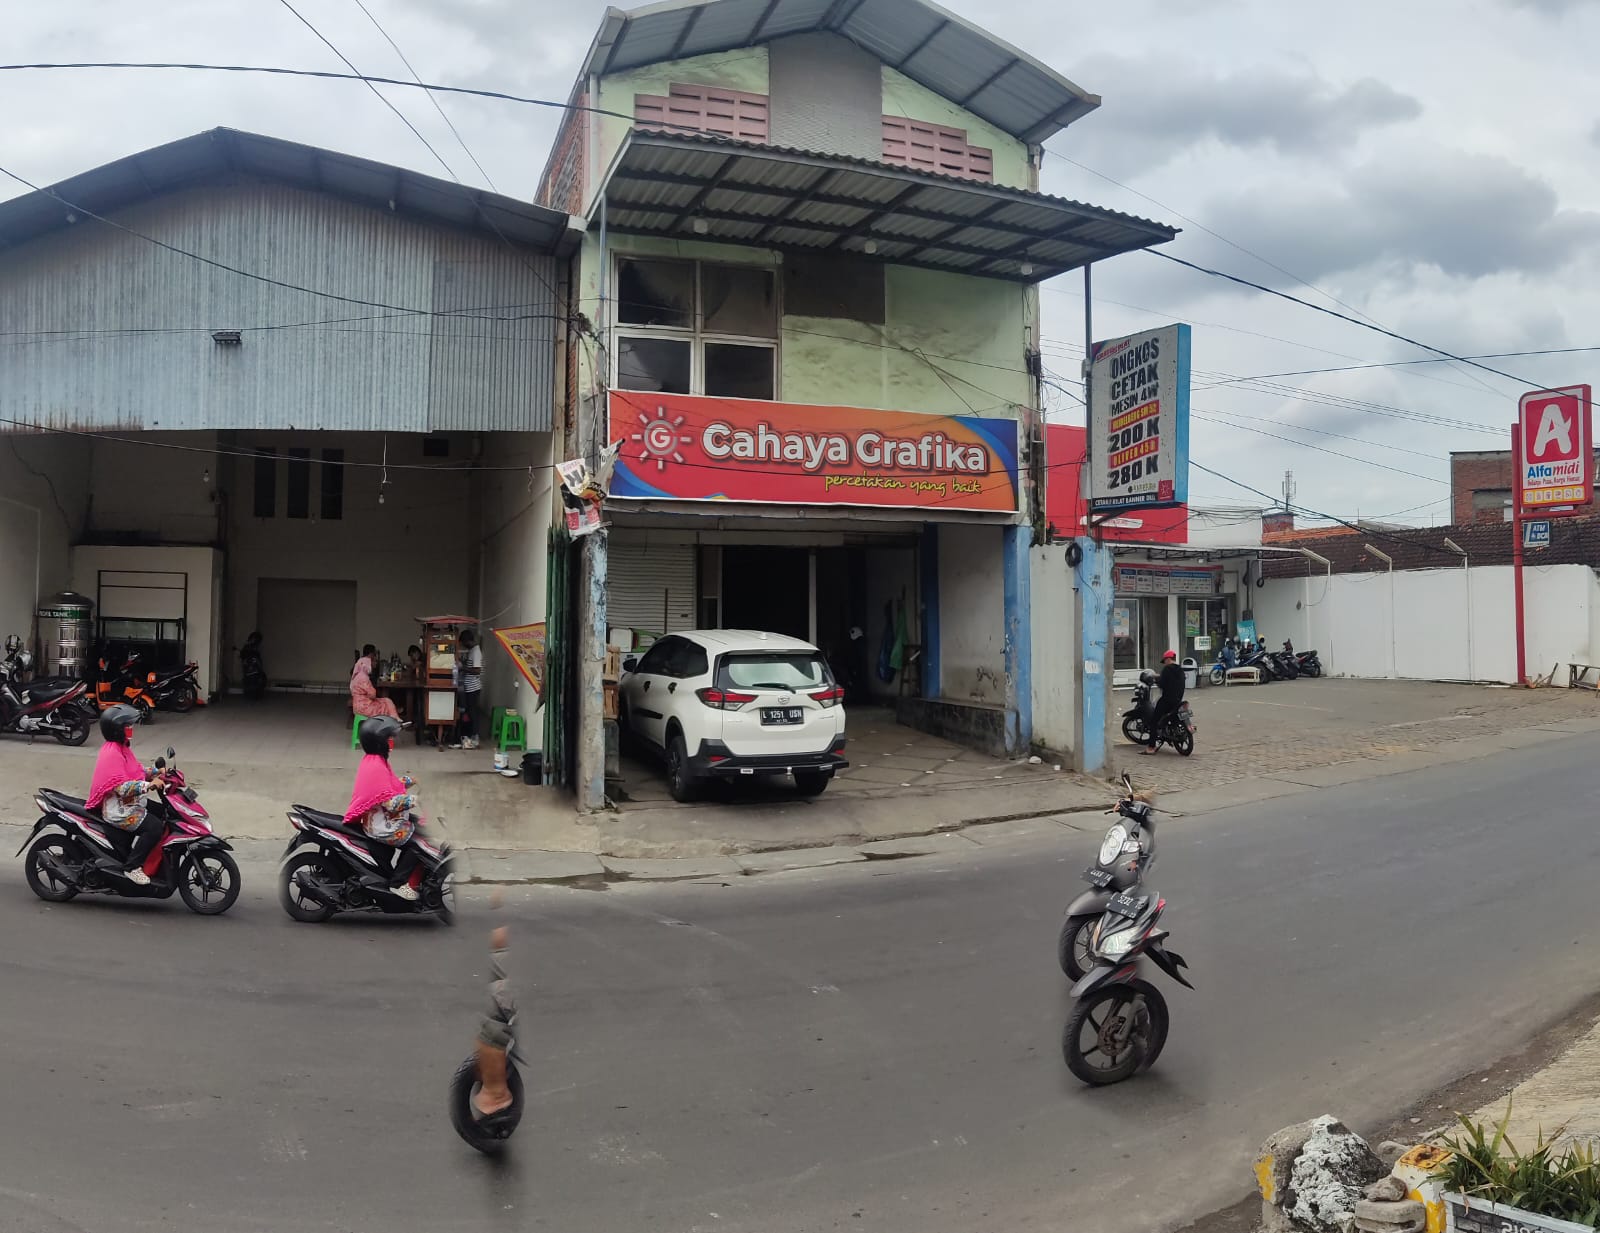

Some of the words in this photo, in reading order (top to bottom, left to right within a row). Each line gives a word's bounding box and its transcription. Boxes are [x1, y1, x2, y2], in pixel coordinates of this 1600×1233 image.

[1111, 337, 1160, 380] ONGKOS
[1111, 361, 1160, 401] CETAK
[1111, 391, 1138, 417] MESIN
[702, 423, 848, 469] Cahaya
[856, 432, 985, 471] Grafika
[1107, 422, 1144, 453] 200
[1146, 416, 1160, 438] K
[824, 471, 906, 492] percetakan
[909, 479, 947, 497] yang
[952, 475, 982, 494] baik
[1107, 460, 1143, 489] 280
[1146, 454, 1159, 475] K
[1528, 461, 1580, 478] Alfamidi
